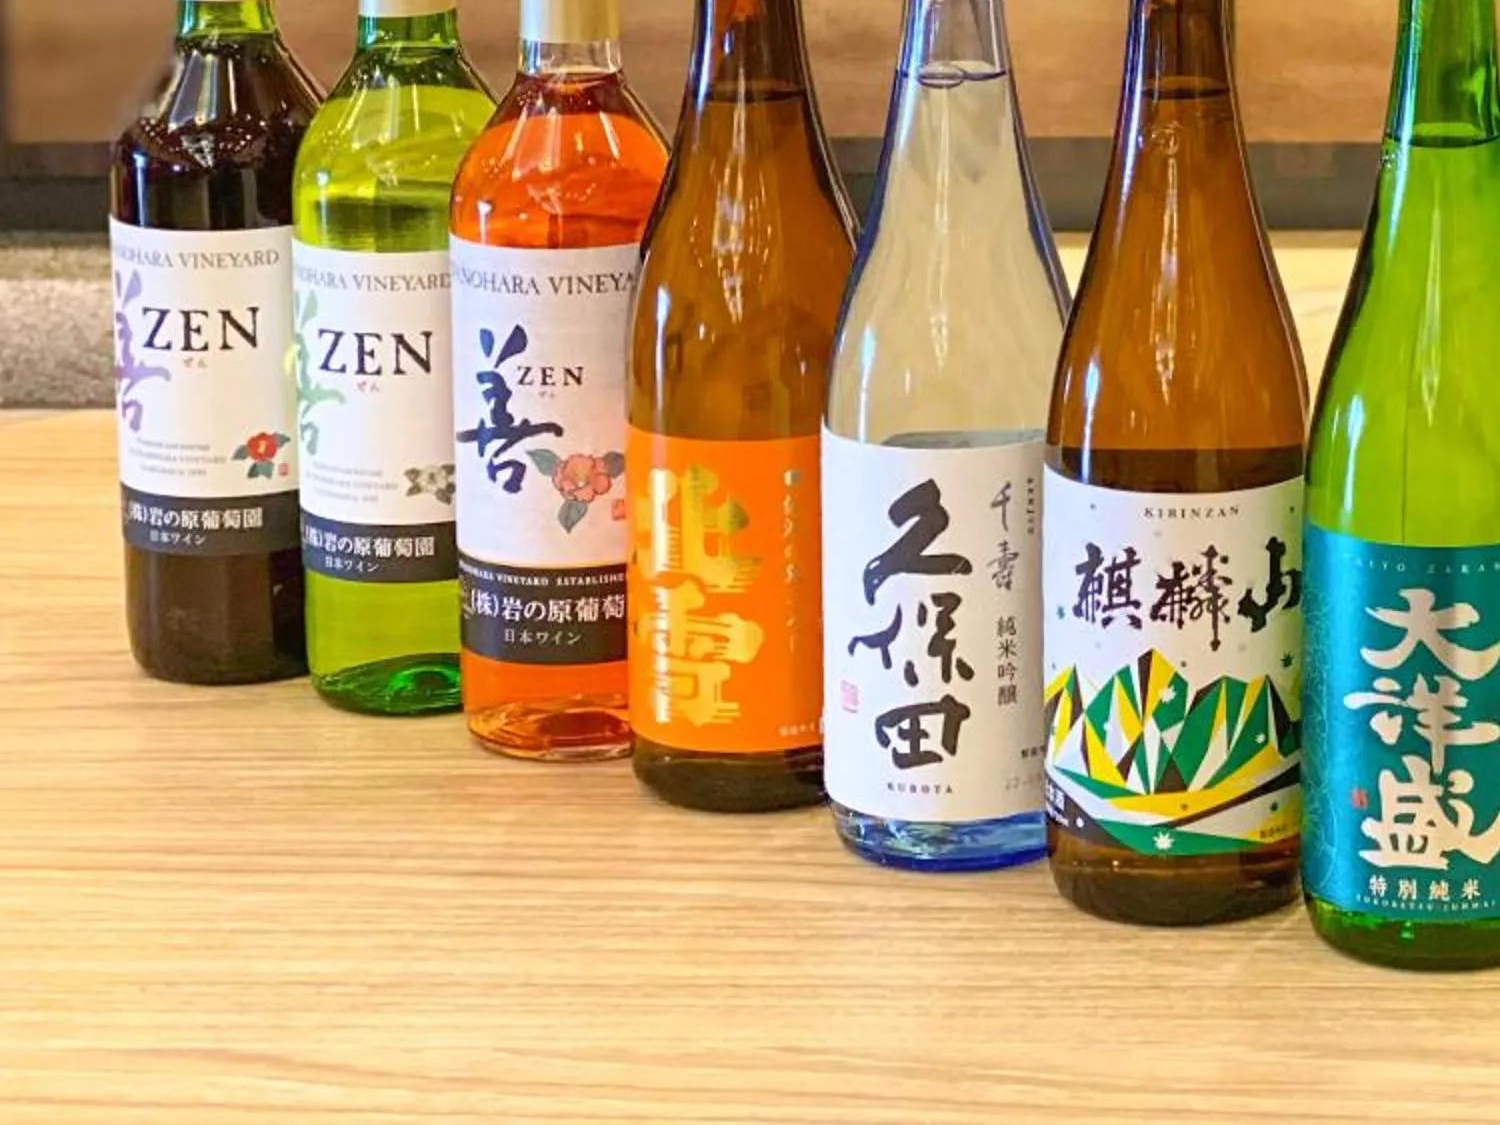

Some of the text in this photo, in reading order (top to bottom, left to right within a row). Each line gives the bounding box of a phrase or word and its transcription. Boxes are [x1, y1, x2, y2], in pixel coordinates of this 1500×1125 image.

[178, 250, 279, 269] VINEYARD
[547, 272, 639, 295] VINEYA
[142, 306, 260, 352] ZEN
[318, 328, 433, 375] ZEN
[517, 366, 584, 386] ZEN
[1145, 505, 1240, 518] KIRINZAN
[471, 589, 625, 623] (株)岩の原葡萄
[1073, 537, 1301, 651] 麒麟山
[504, 629, 582, 645] 日本ワイン
[848, 478, 973, 770] 久保田
[996, 616, 1018, 706] 純米吟醸
[887, 781, 954, 794] KUBOTA
[1369, 875, 1481, 901] 特別純米
